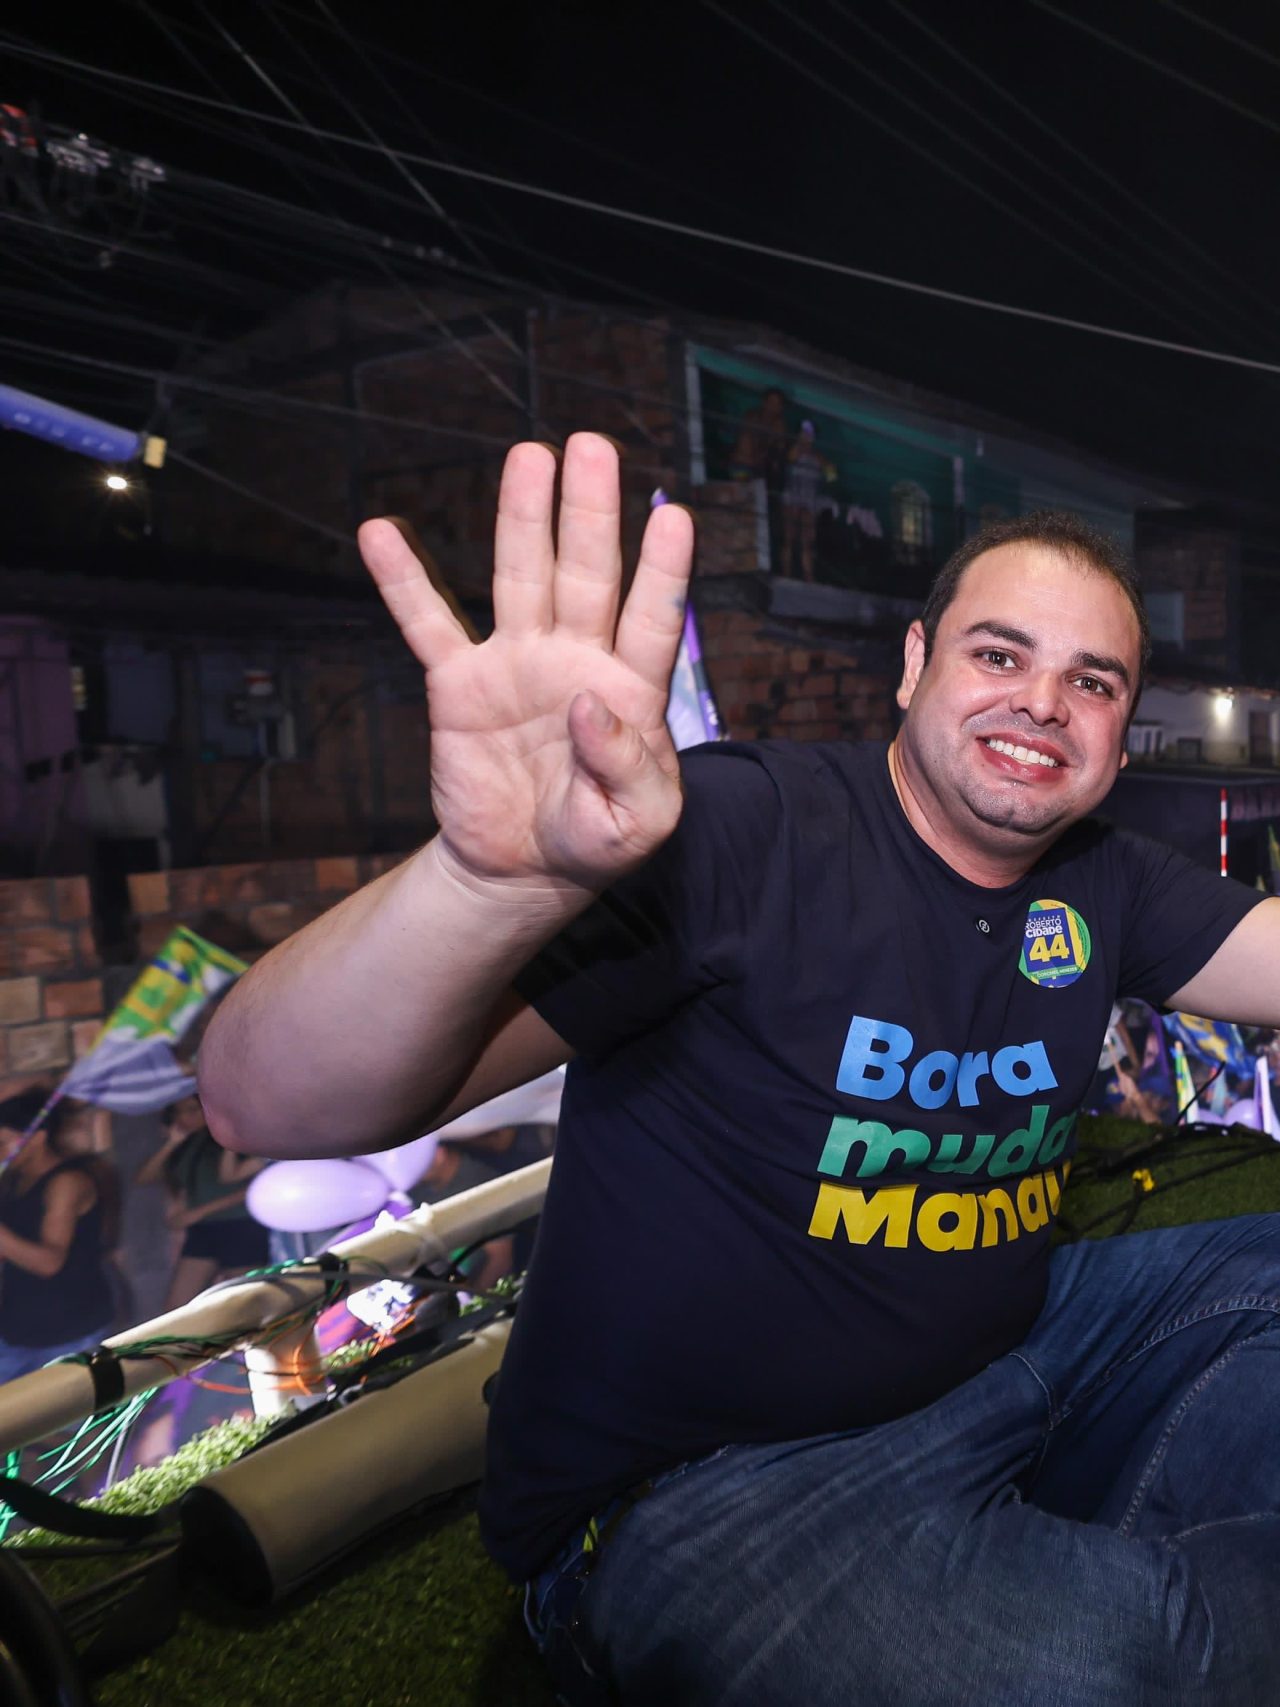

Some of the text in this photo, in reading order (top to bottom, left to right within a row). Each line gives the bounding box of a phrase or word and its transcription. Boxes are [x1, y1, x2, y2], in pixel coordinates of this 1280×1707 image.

[1025, 918, 1062, 931] ROBERTO
[1029, 934, 1070, 962] 44
[836, 1015, 1059, 1110] Bora
[817, 1104, 1078, 1178] muda
